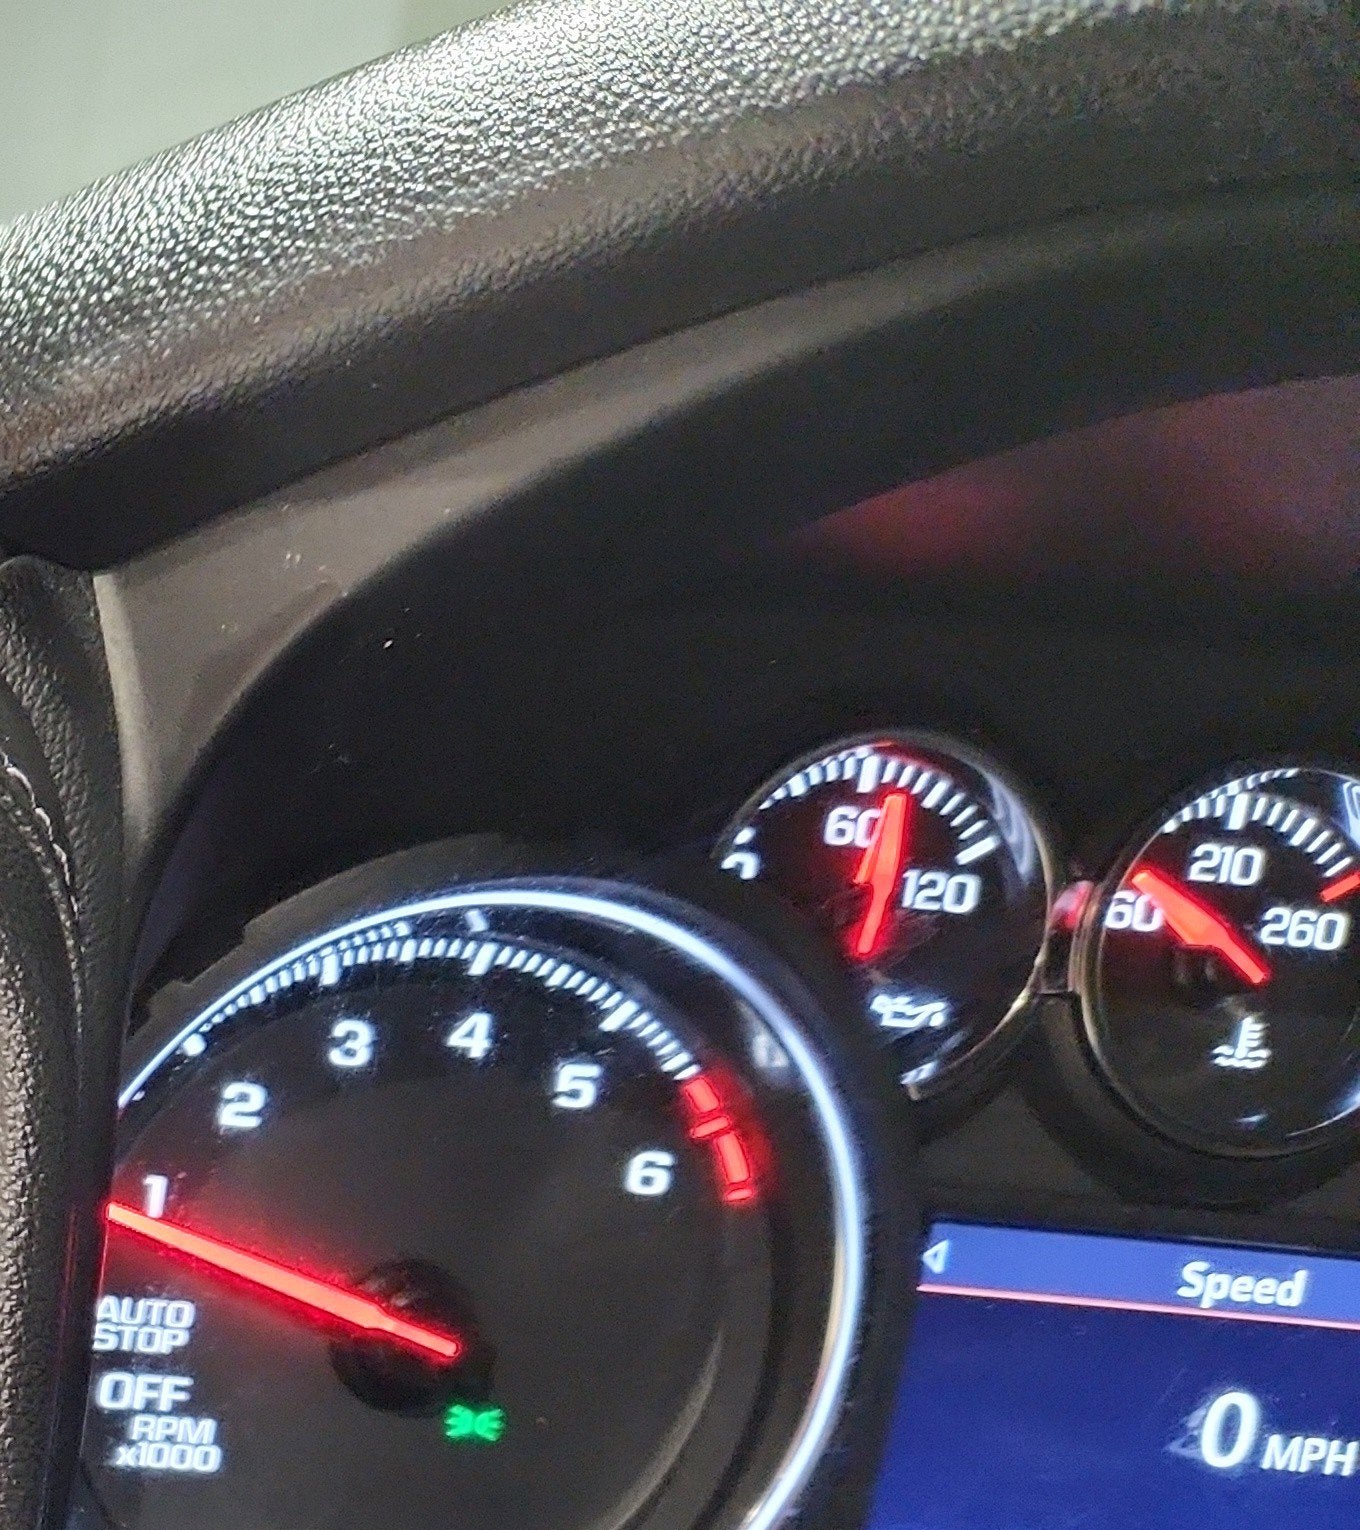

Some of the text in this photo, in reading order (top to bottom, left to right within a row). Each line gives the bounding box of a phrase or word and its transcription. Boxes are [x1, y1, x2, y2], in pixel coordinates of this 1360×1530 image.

[823, 805, 882, 848] 60
[1189, 844, 1264, 886] 210
[901, 869, 980, 913] 120
[1260, 909, 1347, 951] 260
[328, 1019, 374, 1068] 3
[447, 1012, 493, 1057] 4
[217, 1081, 265, 1129] 2
[552, 1064, 601, 1108] 5
[624, 1151, 672, 1196] 6
[142, 1174, 168, 1218] 1
[1176, 1261, 1307, 1309] Speed
[96, 1295, 195, 1328] AUTO
[93, 1323, 189, 1354] STOP
[98, 1372, 194, 1411] OFF
[132, 1415, 217, 1444] RPM
[1199, 1390, 1356, 1477] 0 MPH
